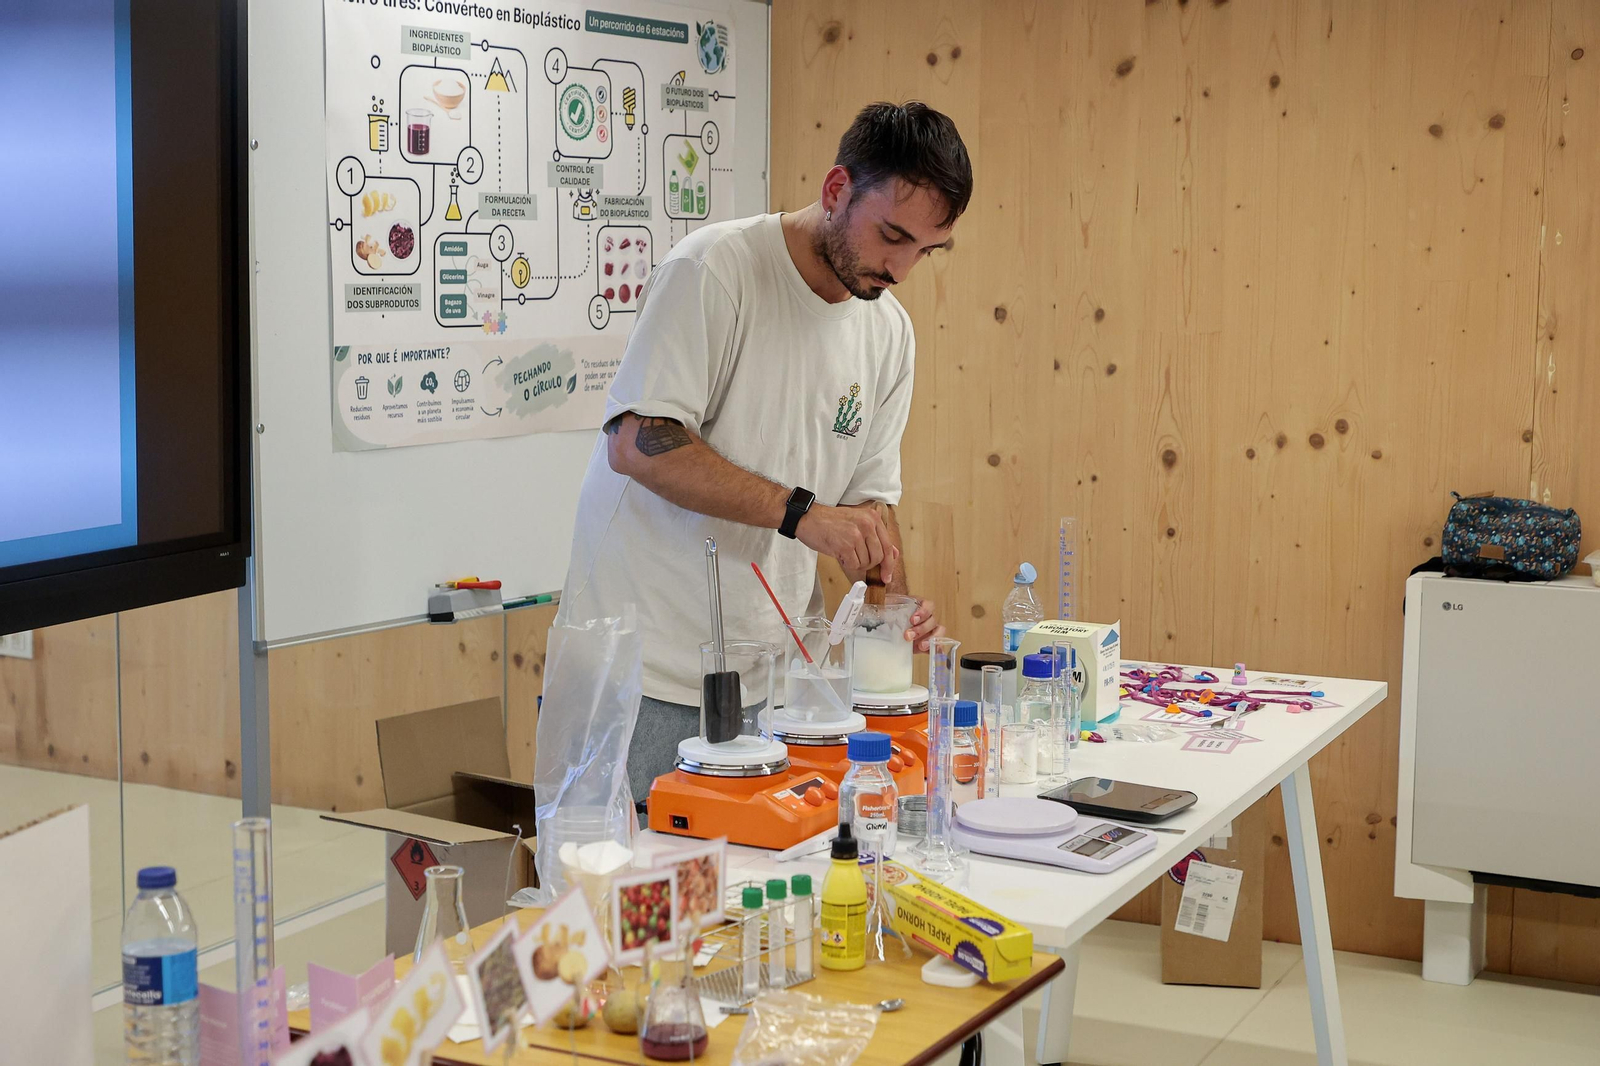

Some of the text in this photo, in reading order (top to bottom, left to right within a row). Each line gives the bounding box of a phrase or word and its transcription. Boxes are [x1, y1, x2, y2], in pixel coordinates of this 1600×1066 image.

[425, 0, 493, 20] Convérteo
[496, 11, 510, 22] en
[514, 8, 581, 30] Bioplástico
[589, 16, 685, 38] Un percorrido de 6 estacións
[409, 30, 464, 43] INGREDIENTES
[412, 43, 462, 56] BIOPLÁSTICO
[552, 58, 560, 74] 4
[671, 88, 692, 97] FUTURO
[693, 90, 704, 98] DOS
[666, 98, 704, 109] BIOPLÁSTICOS
[707, 131, 714, 145] 6
[466, 157, 475, 173] 2
[556, 164, 595, 174] CONTROL DE
[347, 167, 354, 184] 1
[560, 177, 591, 186] CALIDADE
[484, 194, 532, 205] FORMULACIÓN
[604, 196, 645, 206] FABRICACIÓN
[491, 208, 526, 217] DA RECETA
[610, 208, 650, 218] BIOPLÁSTICO
[498, 235, 506, 251] 3
[353, 284, 413, 296] IDENTIFICACIÓN
[347, 299, 419, 310] DOS SUBPRODUTOS
[596, 304, 603, 319] 5
[358, 347, 451, 365] POR QUE É IMPORTANTE?
[513, 360, 552, 385] PECHANDO
[584, 372, 598, 382] poden
[524, 376, 562, 401] O CÍRCULO
[1038, 625, 1089, 633] LABORATORY
[414, 881, 419, 891] 3
[897, 907, 925, 929] HORNO
[928, 924, 951, 946] PAPEL
